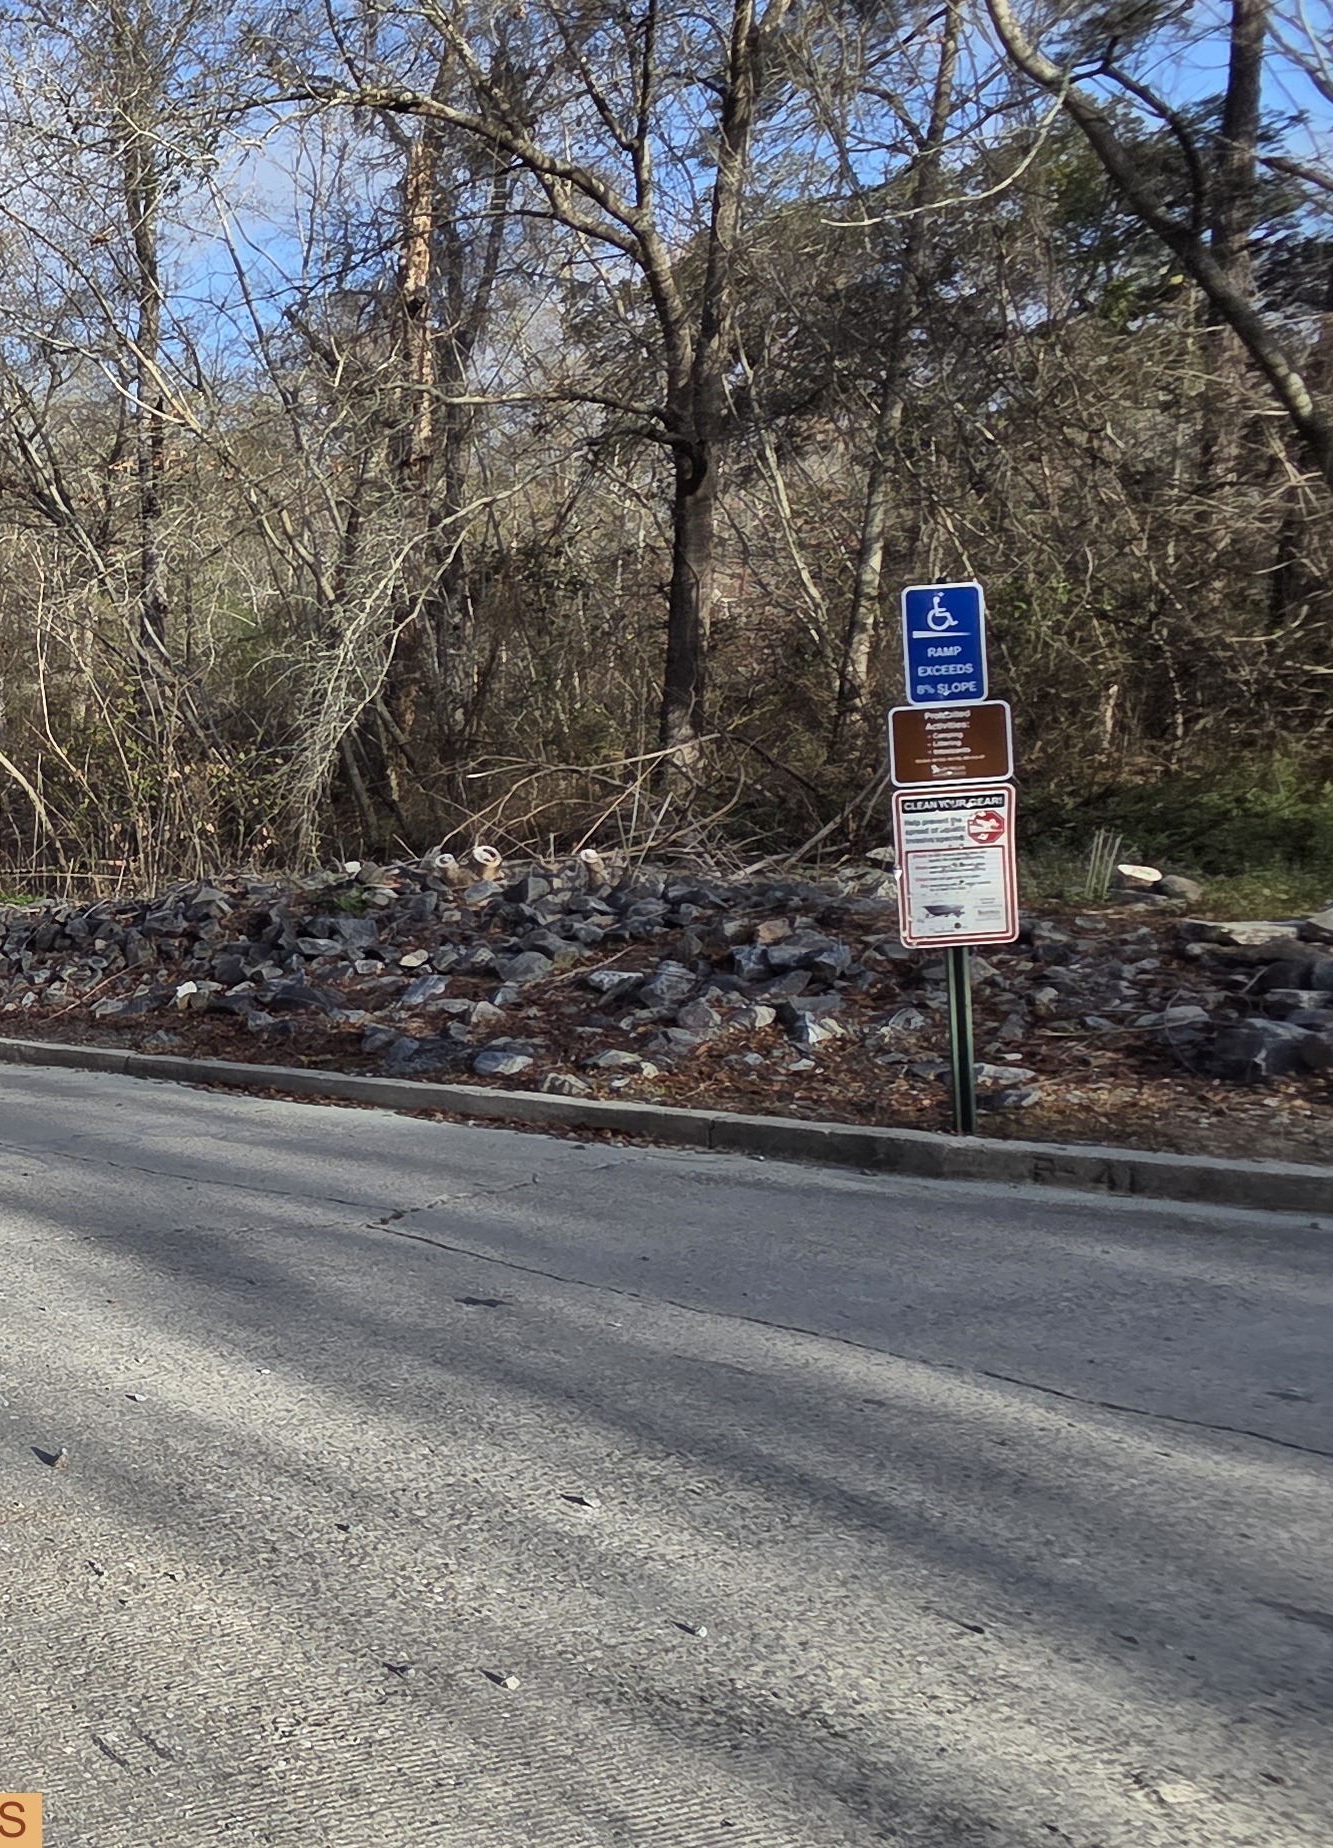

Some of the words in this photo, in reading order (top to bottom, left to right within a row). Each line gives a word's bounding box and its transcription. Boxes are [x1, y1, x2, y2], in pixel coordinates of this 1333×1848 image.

[927, 646, 963, 658] RAMP
[917, 663, 974, 677] EXCEEDS
[937, 681, 977, 694] SLOPE
[904, 801, 938, 811] CLEAN
[938, 799, 967, 808] YOUR
[969, 796, 1003, 806] GEAR!
